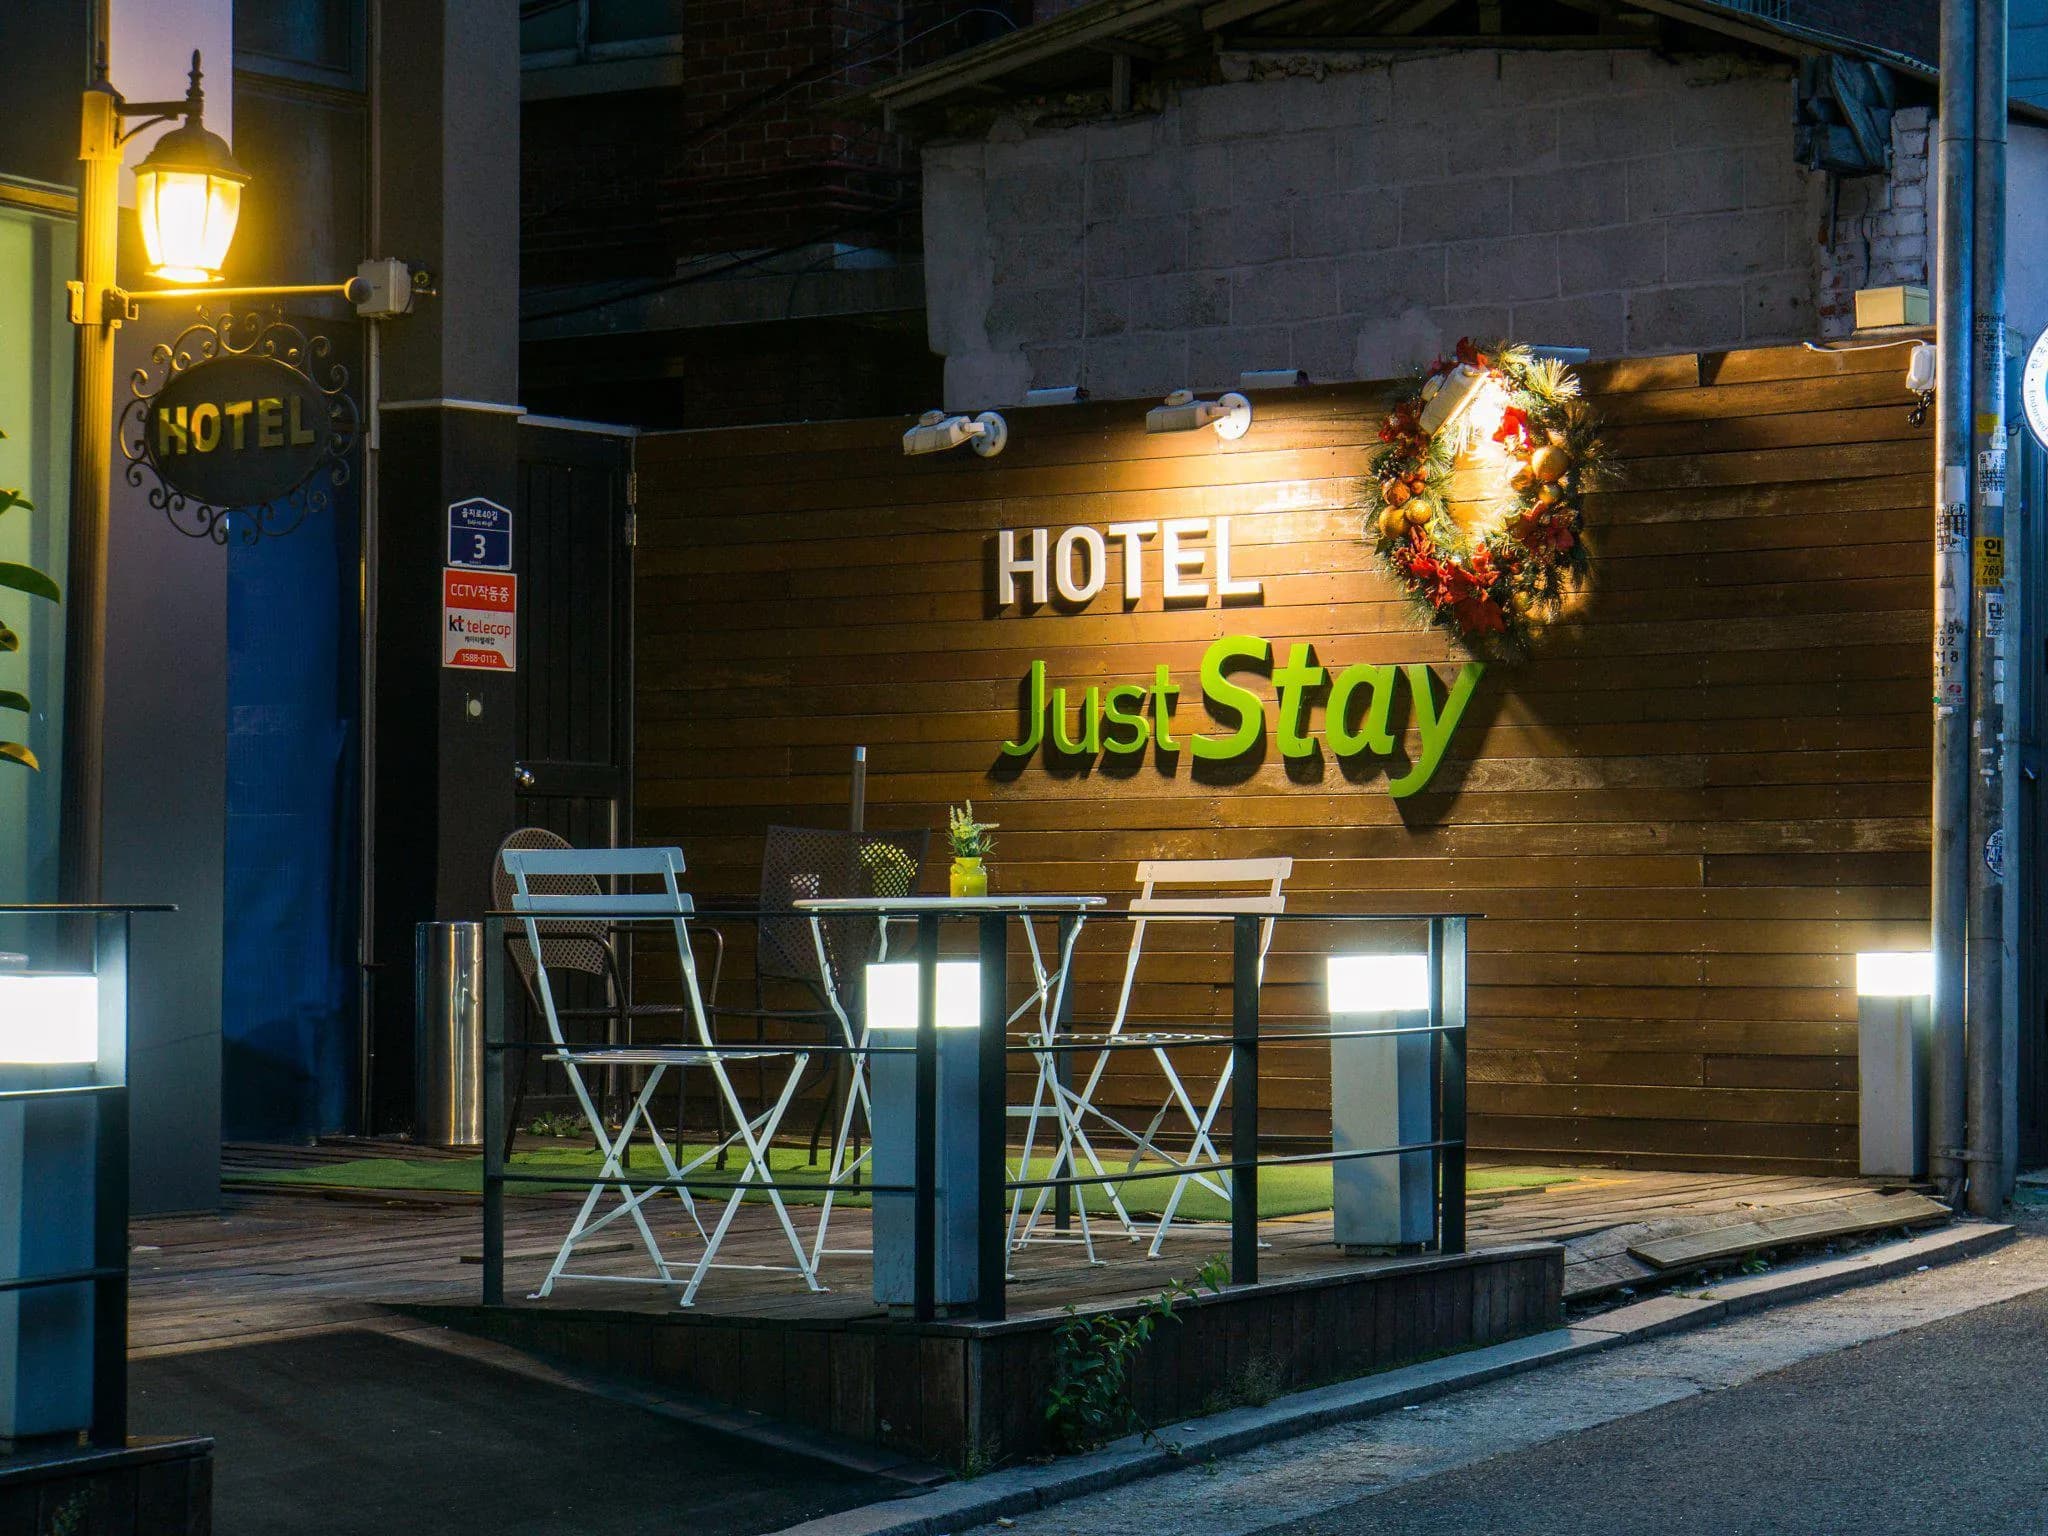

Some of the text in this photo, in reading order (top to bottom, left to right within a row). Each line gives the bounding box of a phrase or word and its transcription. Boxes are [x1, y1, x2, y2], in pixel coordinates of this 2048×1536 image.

[158, 395, 316, 456] HOTEL
[473, 534, 486, 559] 3
[999, 515, 1263, 606] HOTEL
[450, 583, 510, 603] CCTV작동중
[449, 614, 511, 638] kt telecop
[461, 653, 498, 664] 1588-0112
[1002, 635, 1486, 799] Just Stay
